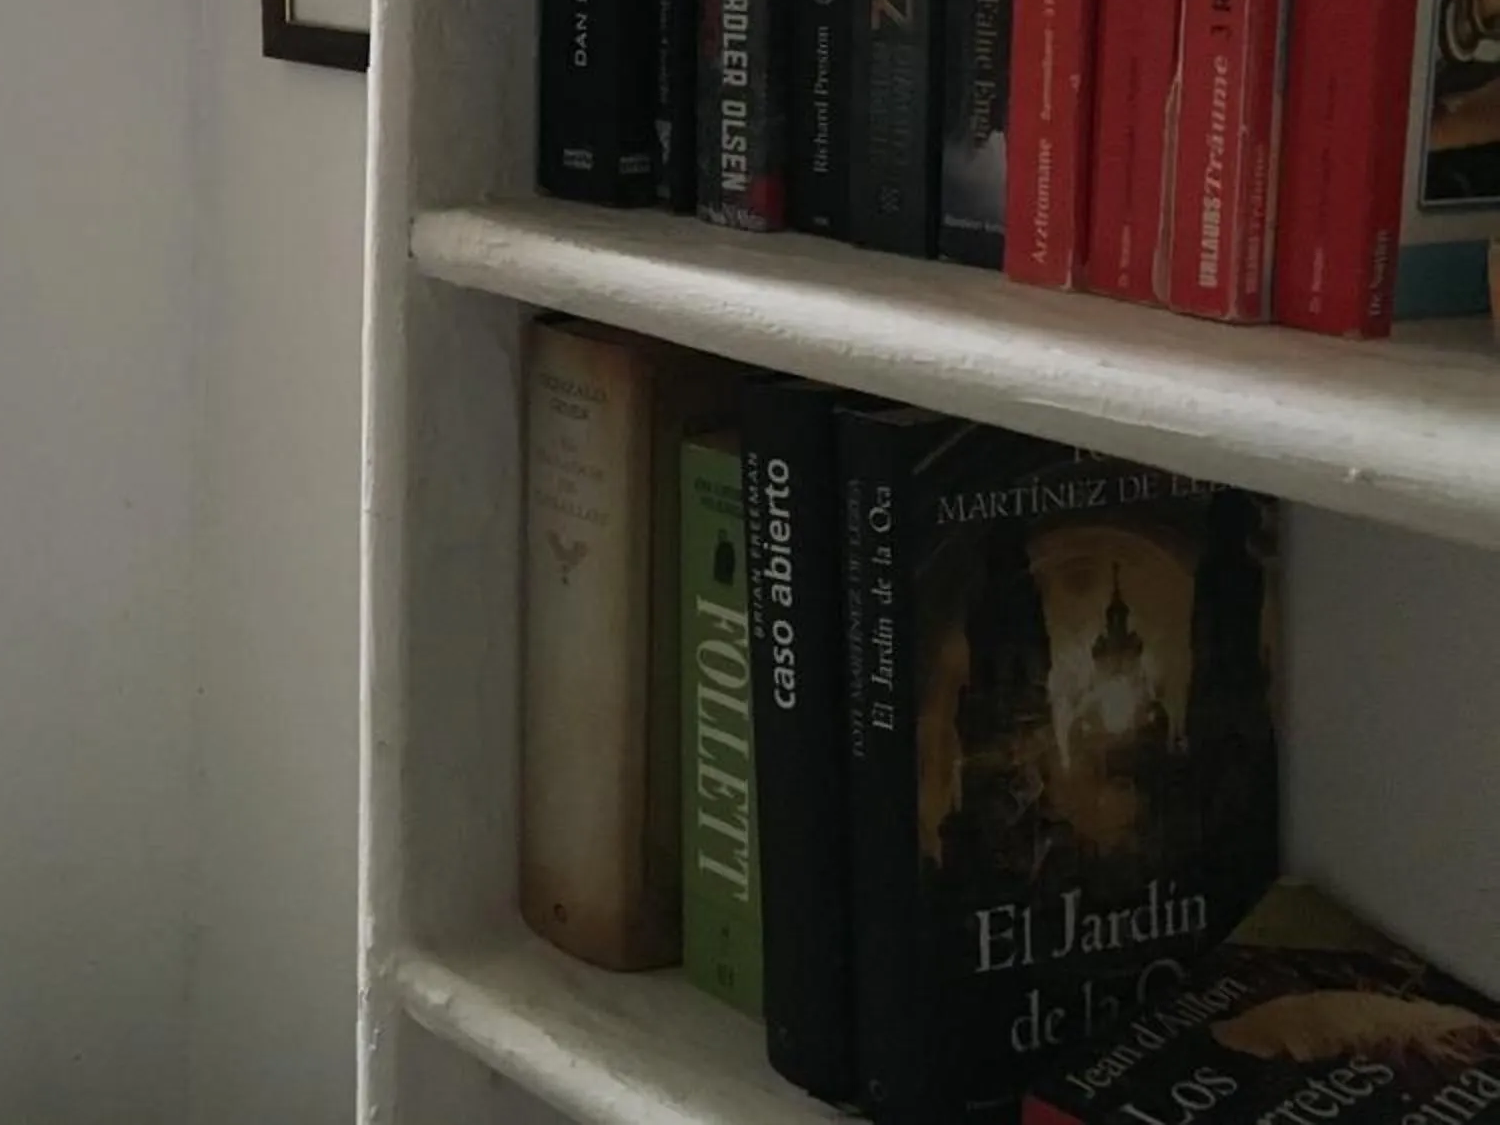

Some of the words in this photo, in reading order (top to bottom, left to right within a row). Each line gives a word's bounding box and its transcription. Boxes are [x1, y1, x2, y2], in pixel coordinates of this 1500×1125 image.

[576, 13, 588, 67] DAN
[813, 25, 831, 96] Preston
[721, 100, 748, 192] OLSEN
[813, 98, 831, 173] Richard
[747, 451, 763, 559] FREEMAN
[762, 459, 793, 607] abierto
[867, 485, 892, 534] Oca
[870, 546, 892, 566] la
[870, 578, 893, 605] de
[752, 567, 766, 639] BRIAN
[771, 620, 797, 710] caso
[695, 592, 750, 903] FOLLETT
[871, 702, 894, 731] El
[973, 903, 1035, 974] El
[1010, 988, 1066, 1053] de
[1065, 1041, 1144, 1100] Jean
[1129, 975, 1248, 1051] d'Aillon
[1119, 1065, 1240, 1125] Los
